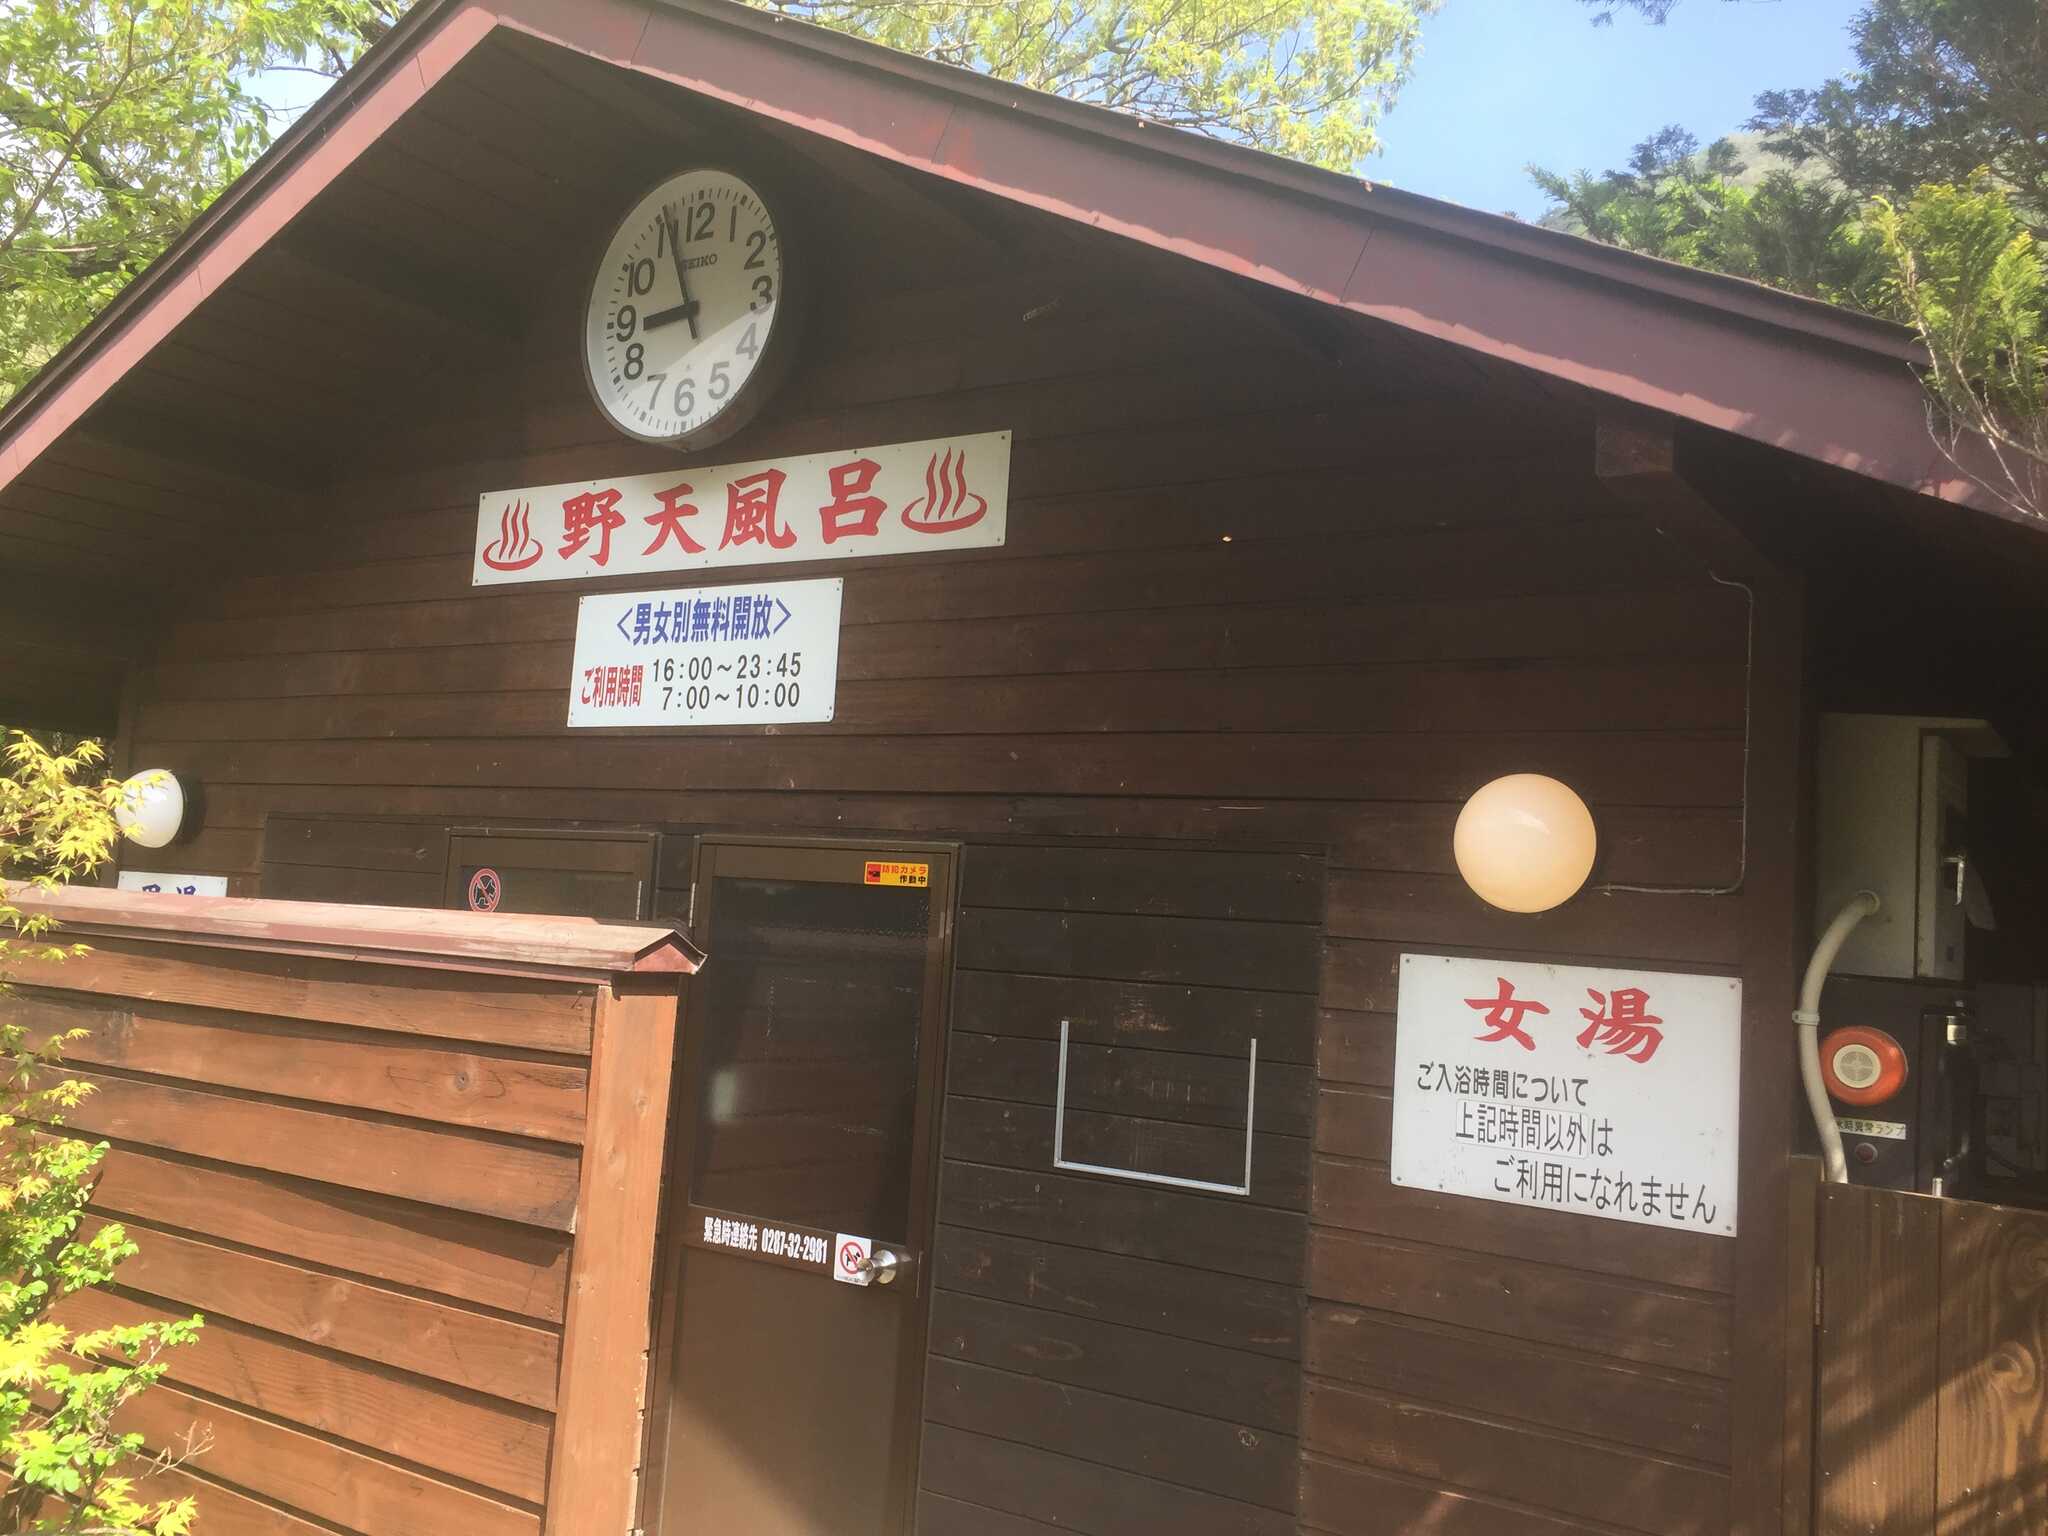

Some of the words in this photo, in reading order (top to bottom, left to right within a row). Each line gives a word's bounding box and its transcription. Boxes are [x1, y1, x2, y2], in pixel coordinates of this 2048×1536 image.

[686, 202, 716, 242] 12
[729, 205, 737, 242] 1
[743, 229, 767, 270] 2
[627, 257, 655, 298] 10
[750, 275, 773, 314] 3
[616, 304, 637, 342] 9
[735, 323, 759, 361] 4
[623, 342, 645, 381] 8
[707, 361, 730, 400] 5
[647, 373, 668, 411] 7
[673, 377, 696, 417] 6
[557, 457, 888, 567] 野天風呂
[580, 664, 644, 708] ご利用時間
[1463, 977, 1664, 1063] 女湯
[1417, 1061, 1589, 1106] ご入浴時間について
[1455, 1101, 1614, 1156] 上記時間以外は
[1494, 1158, 1717, 1224] ご利用になれません
[703, 1216, 758, 1252] 緊急時連絡先
